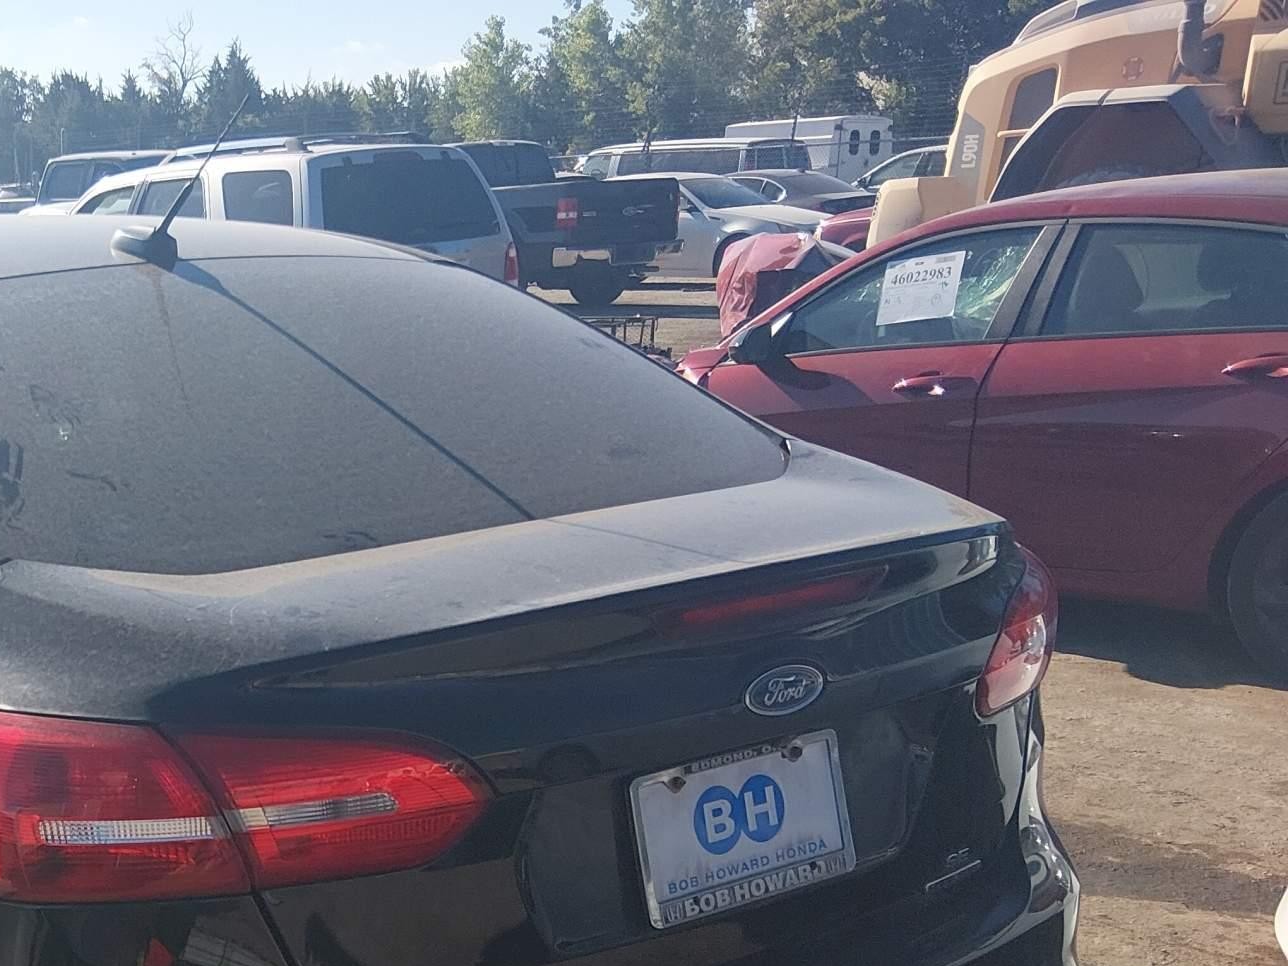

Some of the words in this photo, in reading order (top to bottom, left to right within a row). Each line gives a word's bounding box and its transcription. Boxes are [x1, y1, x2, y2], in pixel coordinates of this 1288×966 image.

[891, 266, 952, 285] 46022983
[764, 675, 811, 706] Ford
[667, 876, 699, 895] BOB
[705, 855, 770, 882] HOWARD
[775, 838, 827, 863] HONDA
[684, 888, 733, 918] BOB
[734, 860, 826, 903] HOWARD
